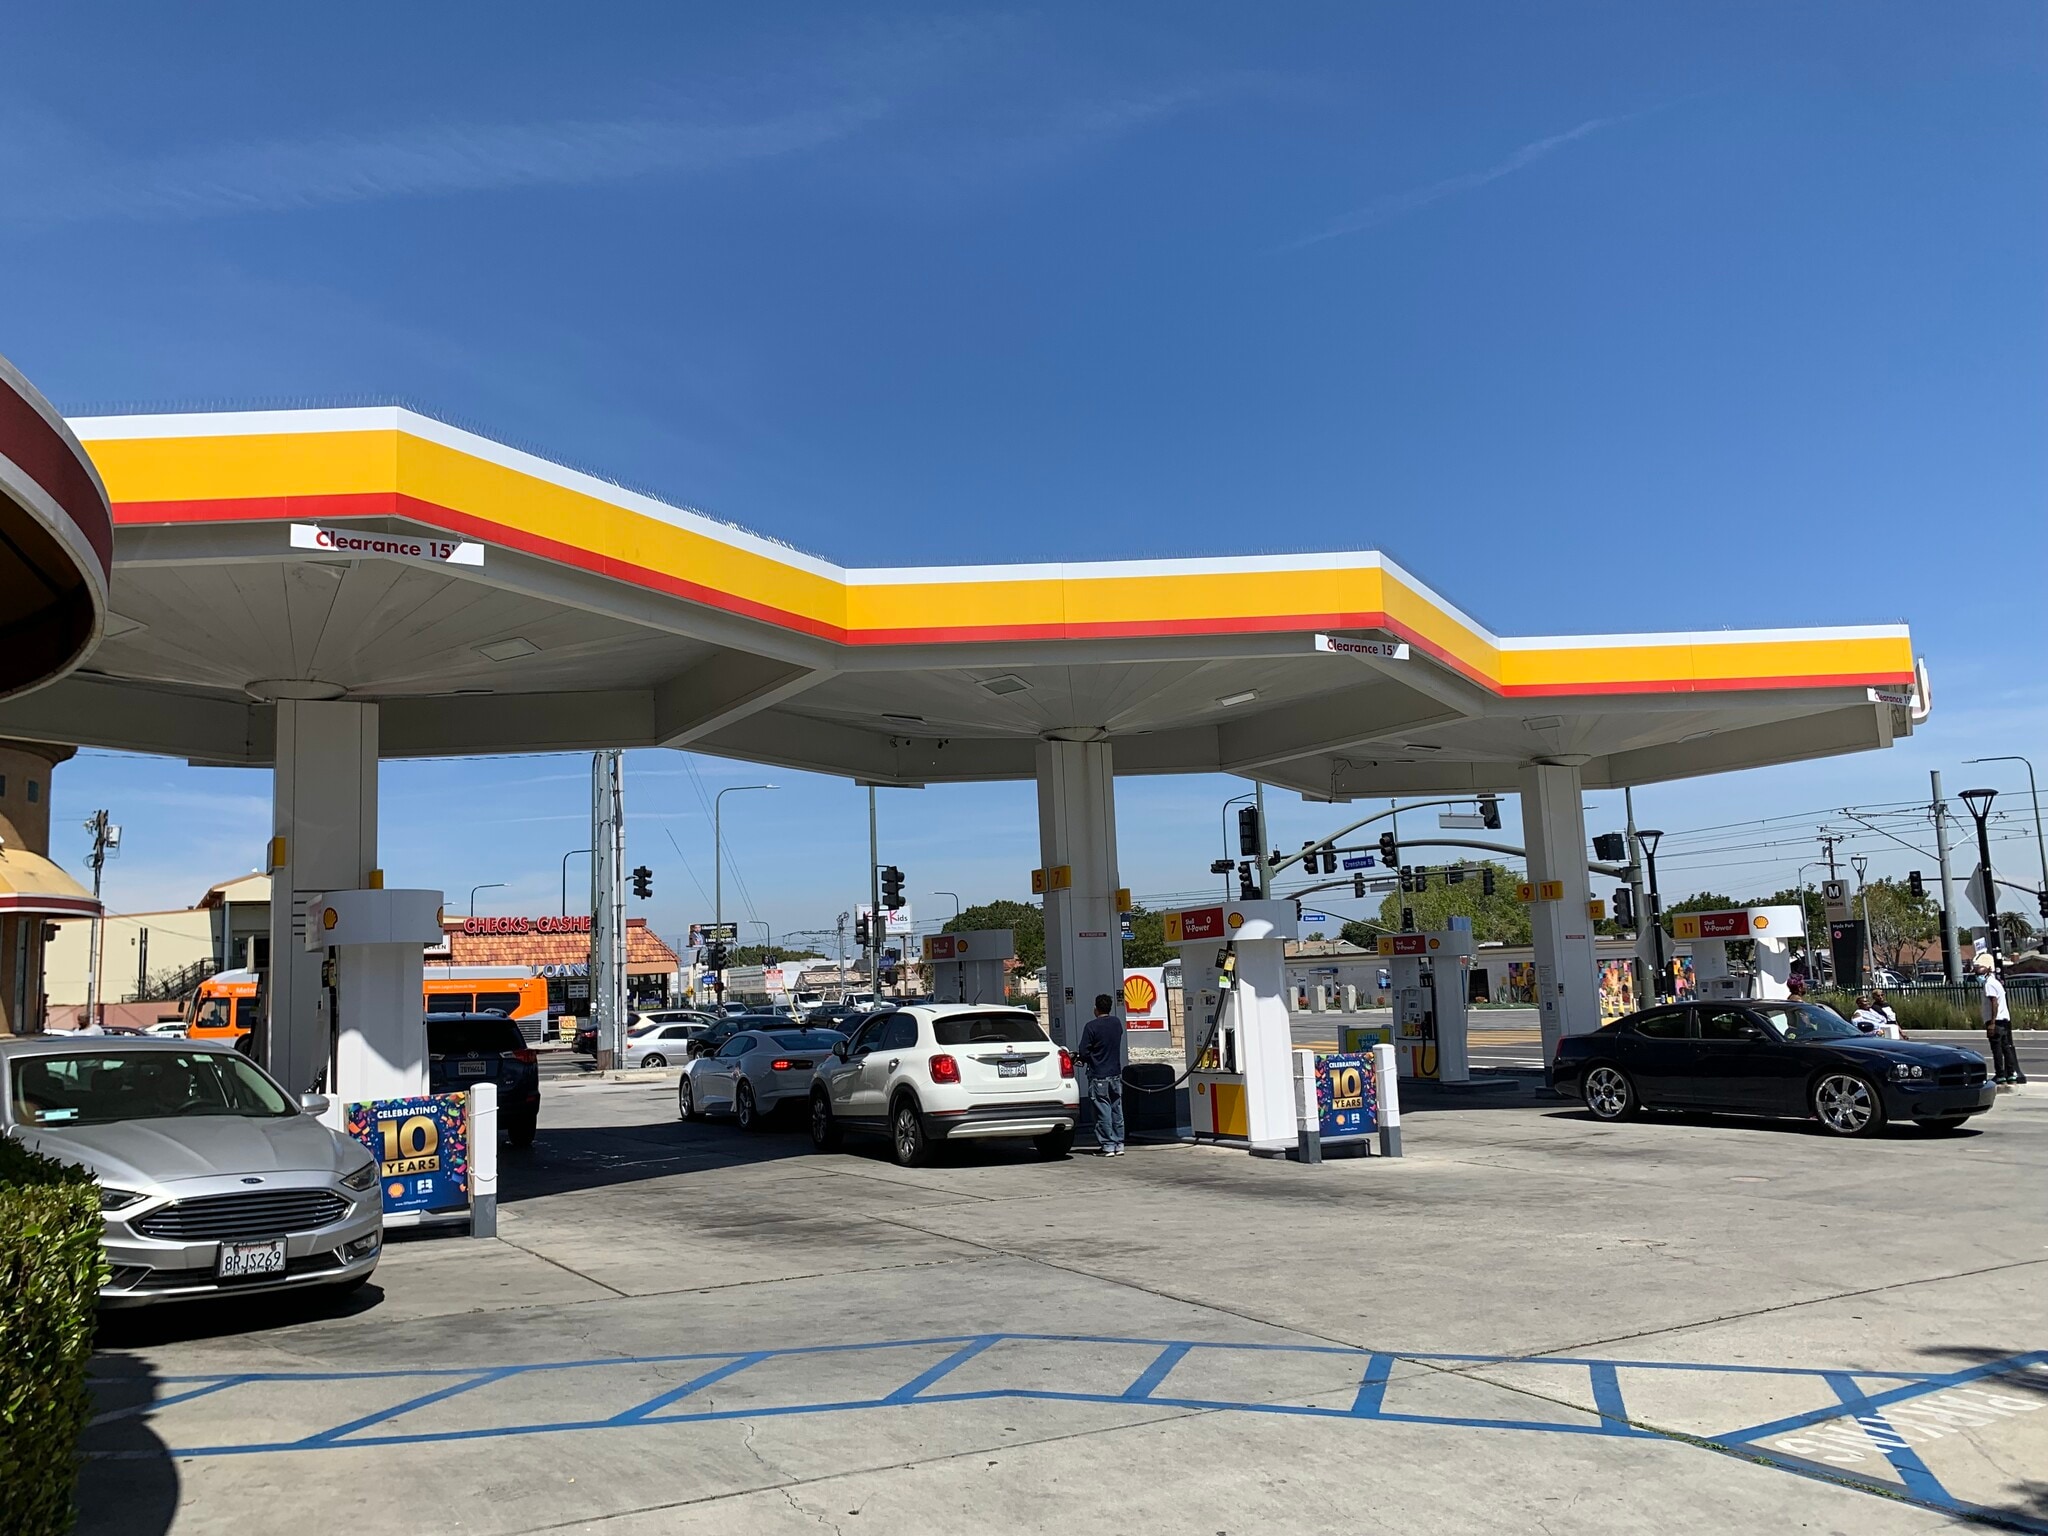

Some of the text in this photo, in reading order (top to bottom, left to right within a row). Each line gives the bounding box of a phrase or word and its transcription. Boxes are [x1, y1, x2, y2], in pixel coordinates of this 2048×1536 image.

[316, 531, 421, 556] Clearance
[1327, 638, 1378, 654] Clearance
[1036, 874, 1042, 888] 5
[1054, 871, 1061, 885] 7
[1522, 887, 1530, 899] 9
[1543, 885, 1553, 897] 11
[1590, 906, 1599, 914] 12
[889, 910, 908, 925] Kids
[1185, 917, 1195, 925] Shell
[464, 916, 592, 934] CHECKS CASHE
[1170, 920, 1177, 934] 7
[1185, 924, 1210, 933] V-Power
[1683, 922, 1693, 934] 11
[1383, 941, 1390, 952] 9
[1329, 1067, 1362, 1098] 10
[1335, 1099, 1361, 1108] YEARS
[377, 1105, 438, 1119] CELEBRATING
[377, 1115, 439, 1161] 10
[386, 1159, 437, 1174] YEARS
[224, 1250, 281, 1271] 8RJS269
